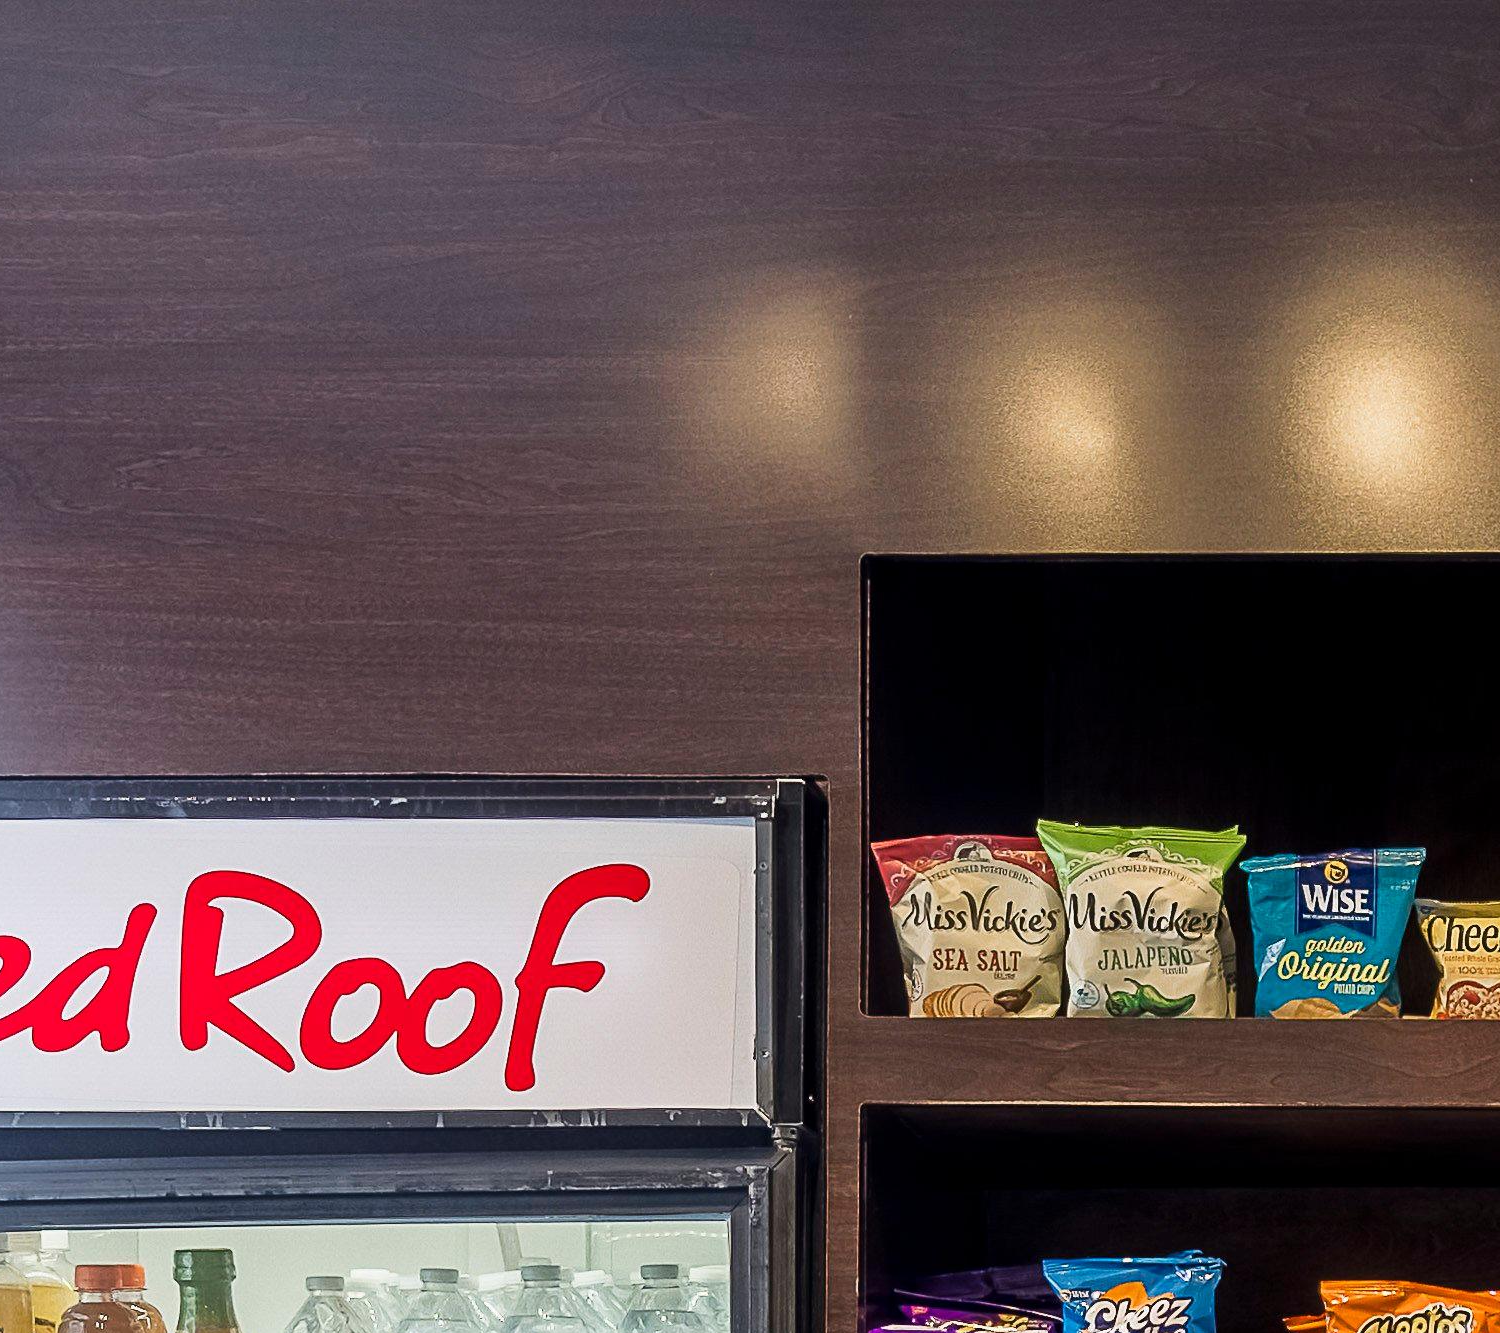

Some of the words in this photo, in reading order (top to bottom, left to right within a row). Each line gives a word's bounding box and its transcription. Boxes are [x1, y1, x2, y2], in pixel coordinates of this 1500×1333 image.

[902, 892, 967, 931] Miss
[960, 886, 1061, 945] Vickie's
[1069, 892, 1132, 932] Miss
[1122, 886, 1219, 941] Vickie's
[1302, 884, 1373, 915] WISE
[933, 949, 969, 971] SEA
[977, 950, 1022, 972] SALT
[1305, 936, 1367, 957] golden
[180, 863, 650, 1091] Roof
[1277, 951, 1391, 990] Original
[1334, 984, 1356, 995] POTATO
[1084, 1299, 1192, 1333] Cheez
